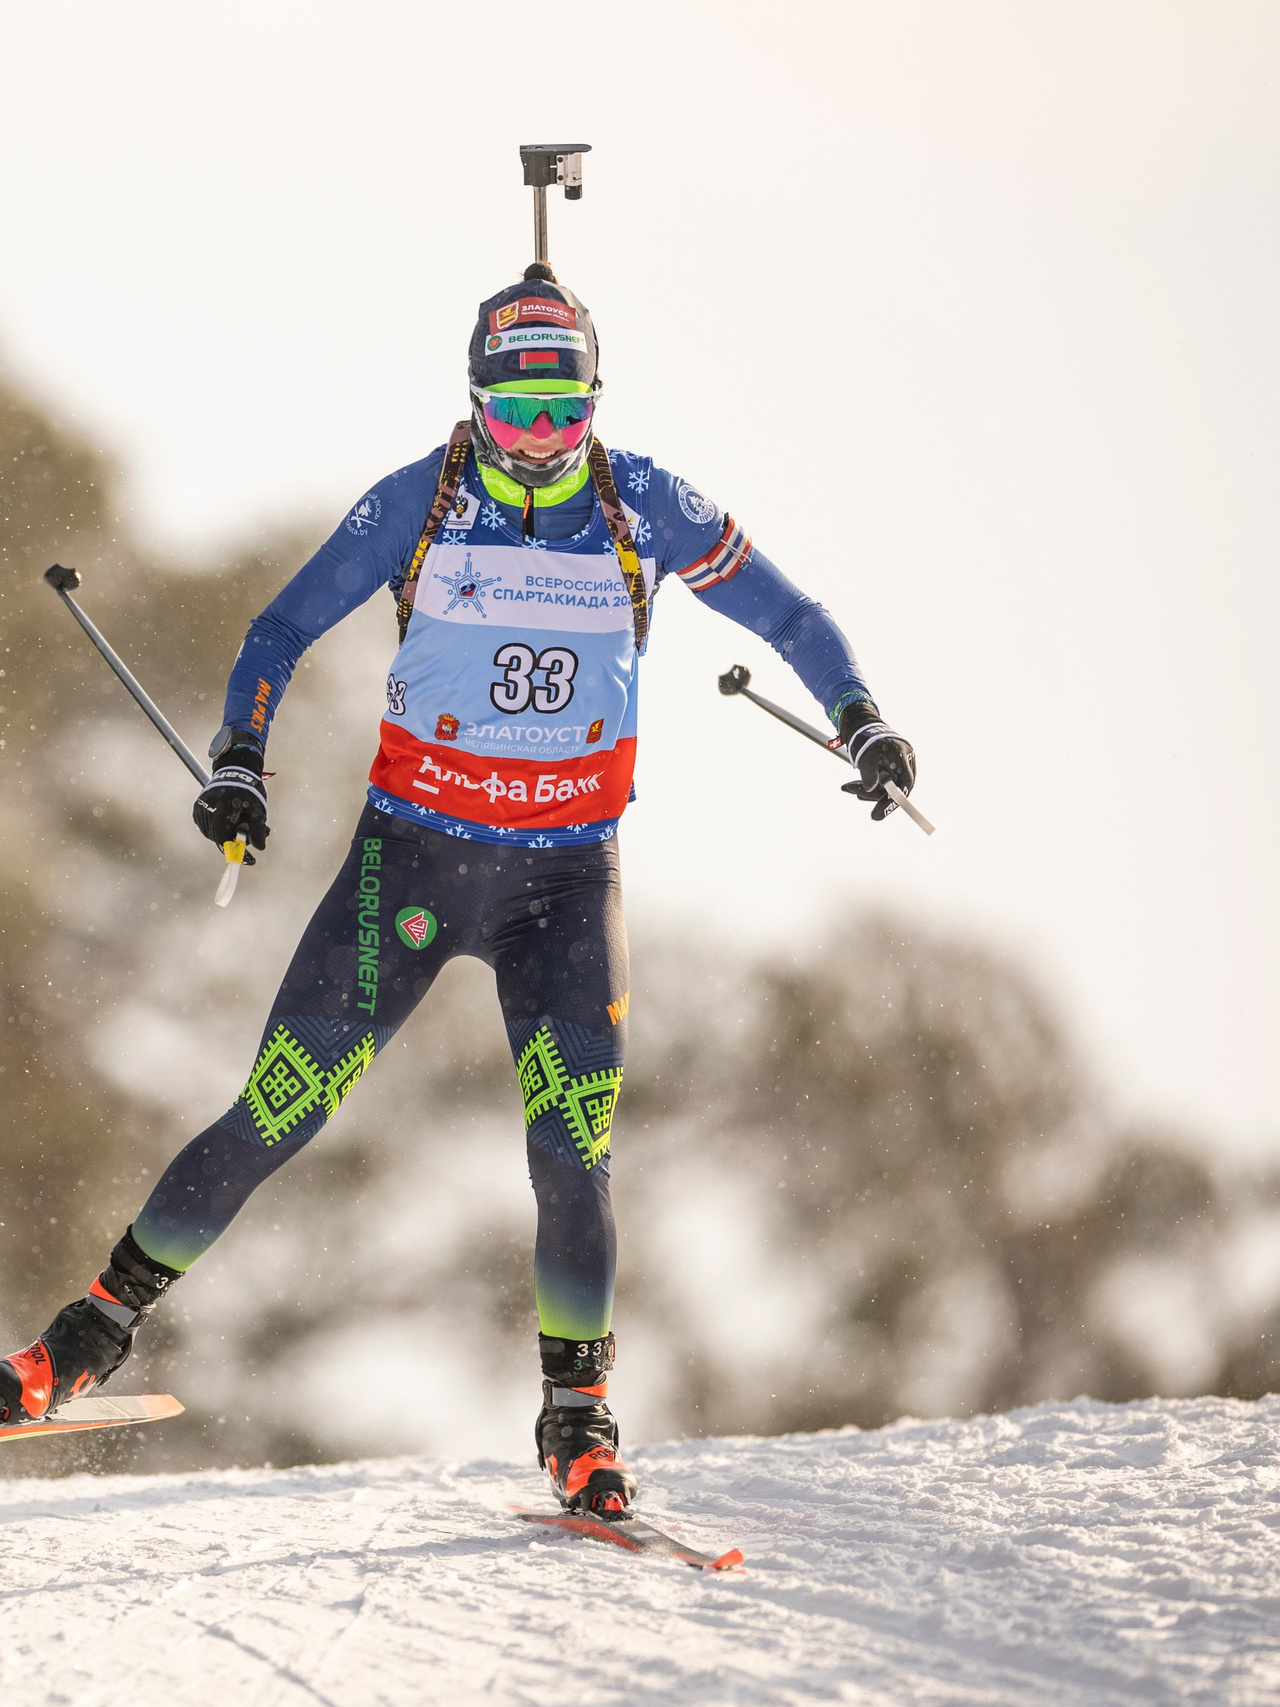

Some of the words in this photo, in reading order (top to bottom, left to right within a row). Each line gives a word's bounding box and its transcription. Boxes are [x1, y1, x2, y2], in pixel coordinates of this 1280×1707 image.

[521, 304, 569, 317] ЗЛАТОУСТ
[508, 333, 585, 345] BELORUSNEFT
[493, 588, 609, 609] СПАРТАКИАДА
[490, 643, 579, 714] 33
[464, 721, 586, 743] ЗЛАТОУСТ
[465, 738, 536, 753] ЧЕЛЯБИНСКАЯ
[419, 755, 528, 804] Альфа
[357, 838, 383, 1016] BELORUSNEFT
[576, 1341, 602, 1357] 33
